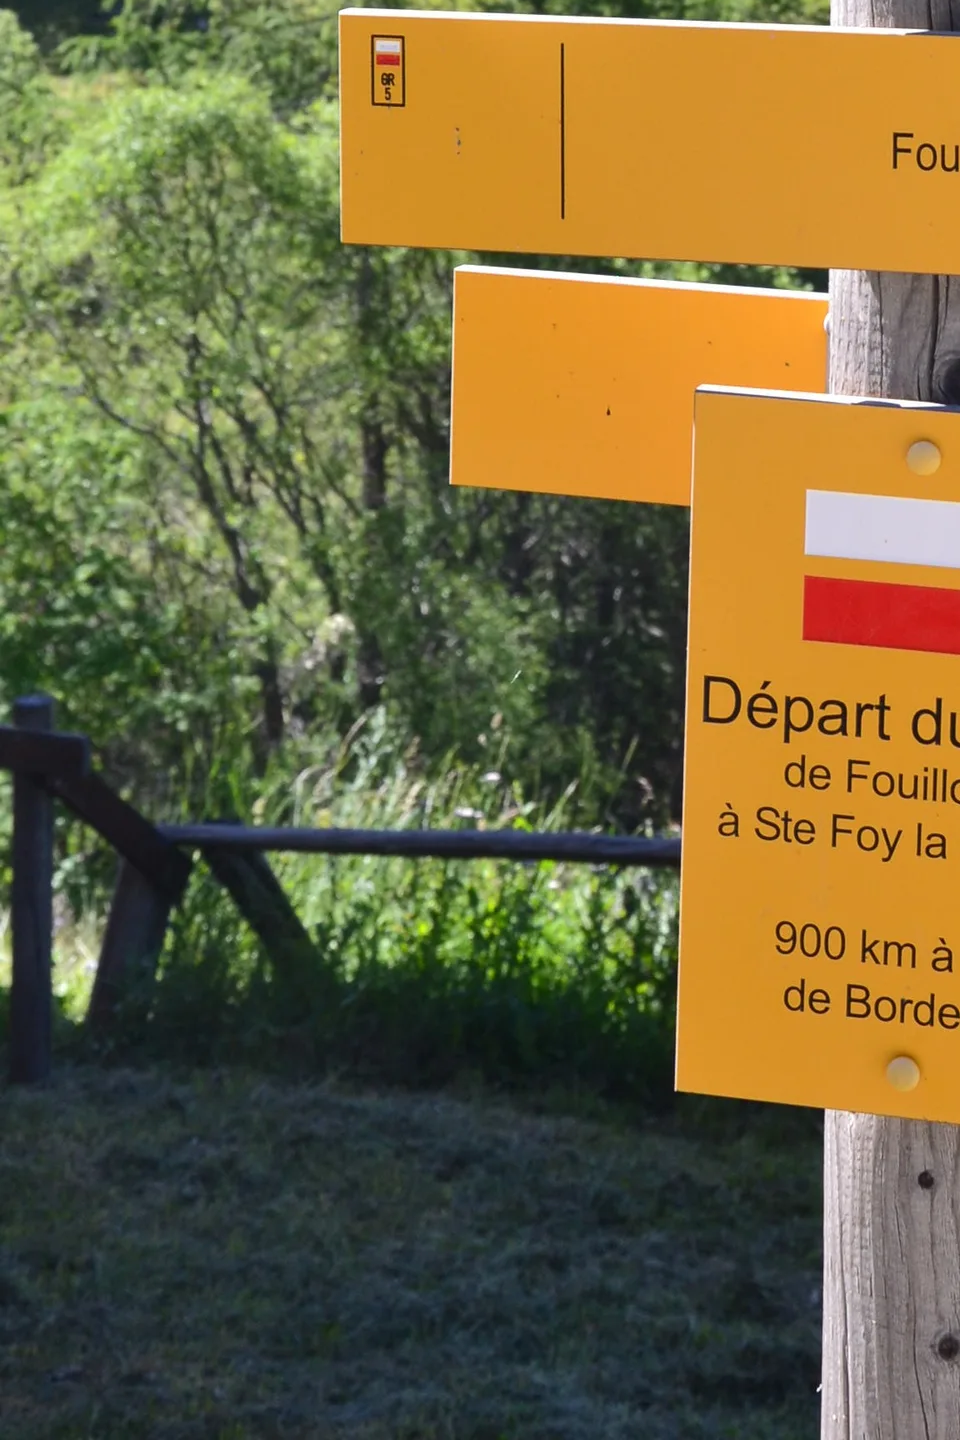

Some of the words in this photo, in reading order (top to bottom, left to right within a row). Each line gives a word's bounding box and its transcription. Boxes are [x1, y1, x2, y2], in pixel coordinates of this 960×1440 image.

[380, 72, 395, 87] GR
[384, 86, 392, 101] 5
[702, 675, 891, 744] Départ
[784, 754, 832, 791] de
[717, 802, 740, 838] à
[754, 806, 816, 845] Ste
[831, 813, 903, 863] Foy
[916, 822, 947, 860] la
[775, 920, 846, 961] 900
[860, 929, 917, 969] km
[931, 937, 953, 973] à
[783, 978, 831, 1015] de
